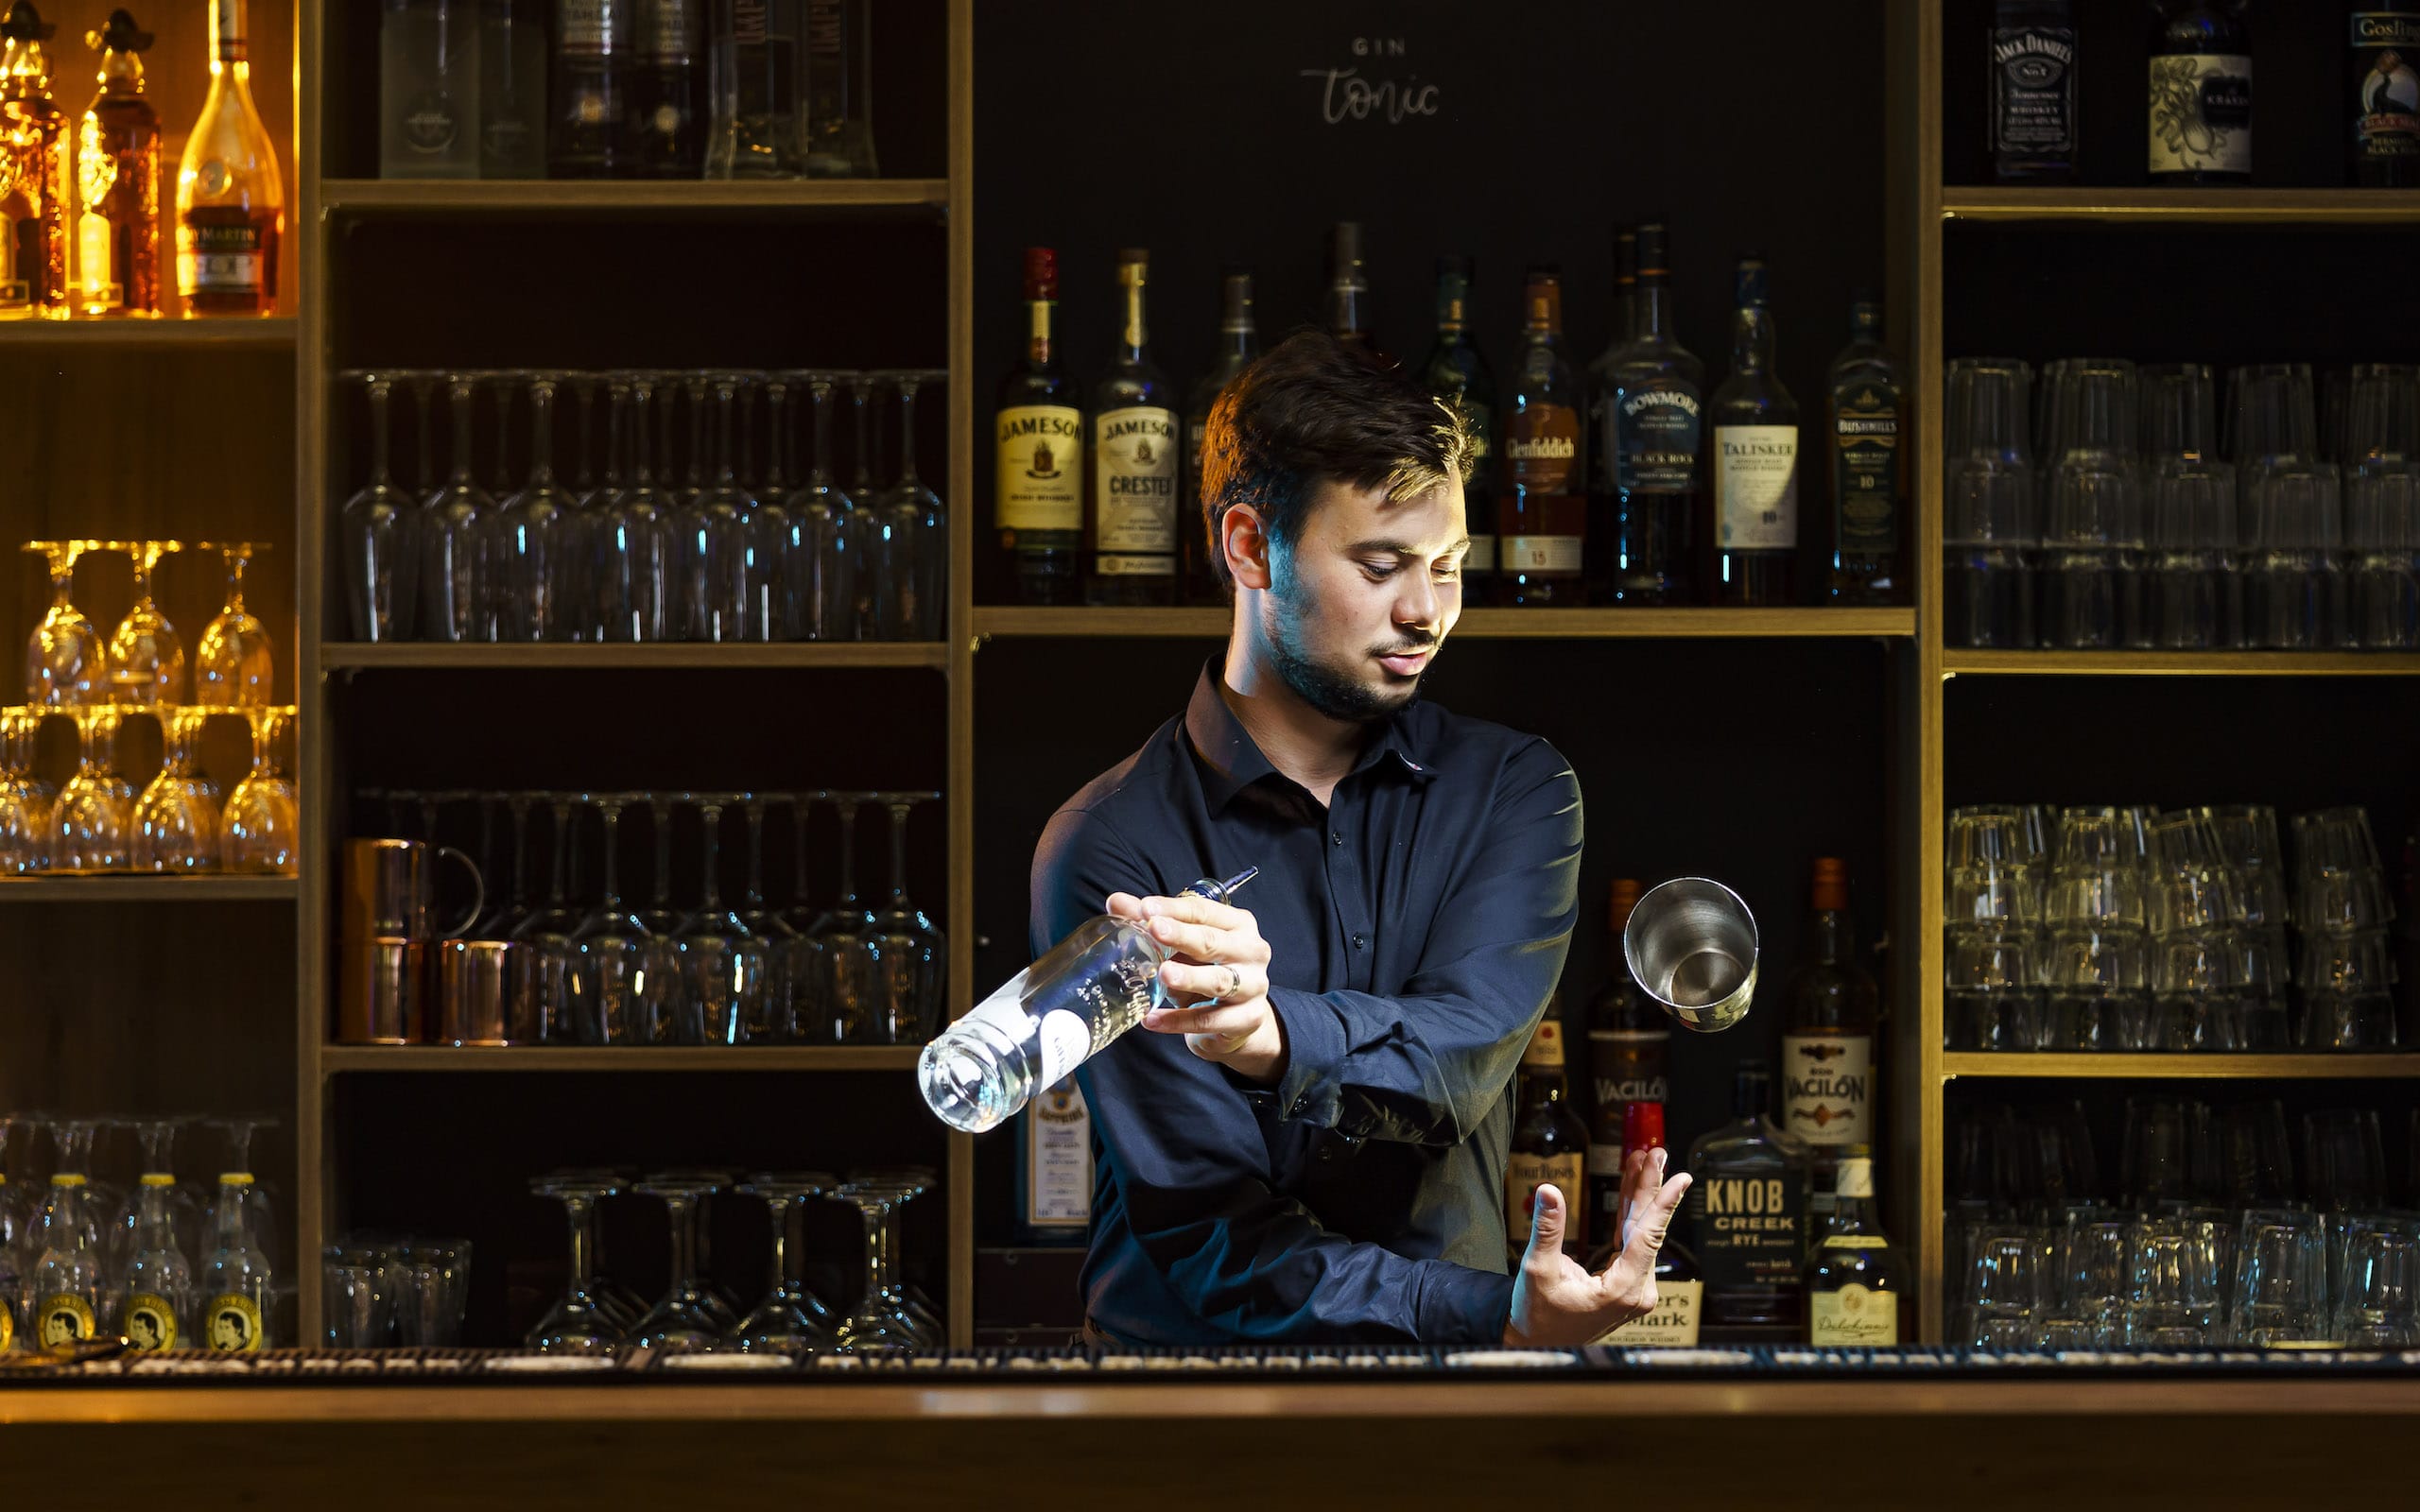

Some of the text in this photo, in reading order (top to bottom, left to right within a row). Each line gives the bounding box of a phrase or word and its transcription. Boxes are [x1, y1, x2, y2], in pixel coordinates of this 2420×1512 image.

[1352, 37, 1406, 56] GIN
[1994, 38, 2026, 64] JACK
[1623, 390, 1702, 418] BOWMORE
[999, 416, 1081, 443] JAMESON
[1105, 419, 1175, 441] JAMESON
[1704, 1177, 1785, 1215] KNOB
[1714, 1216, 1795, 1231] CREEK
[1731, 1232, 1760, 1247] RYE
